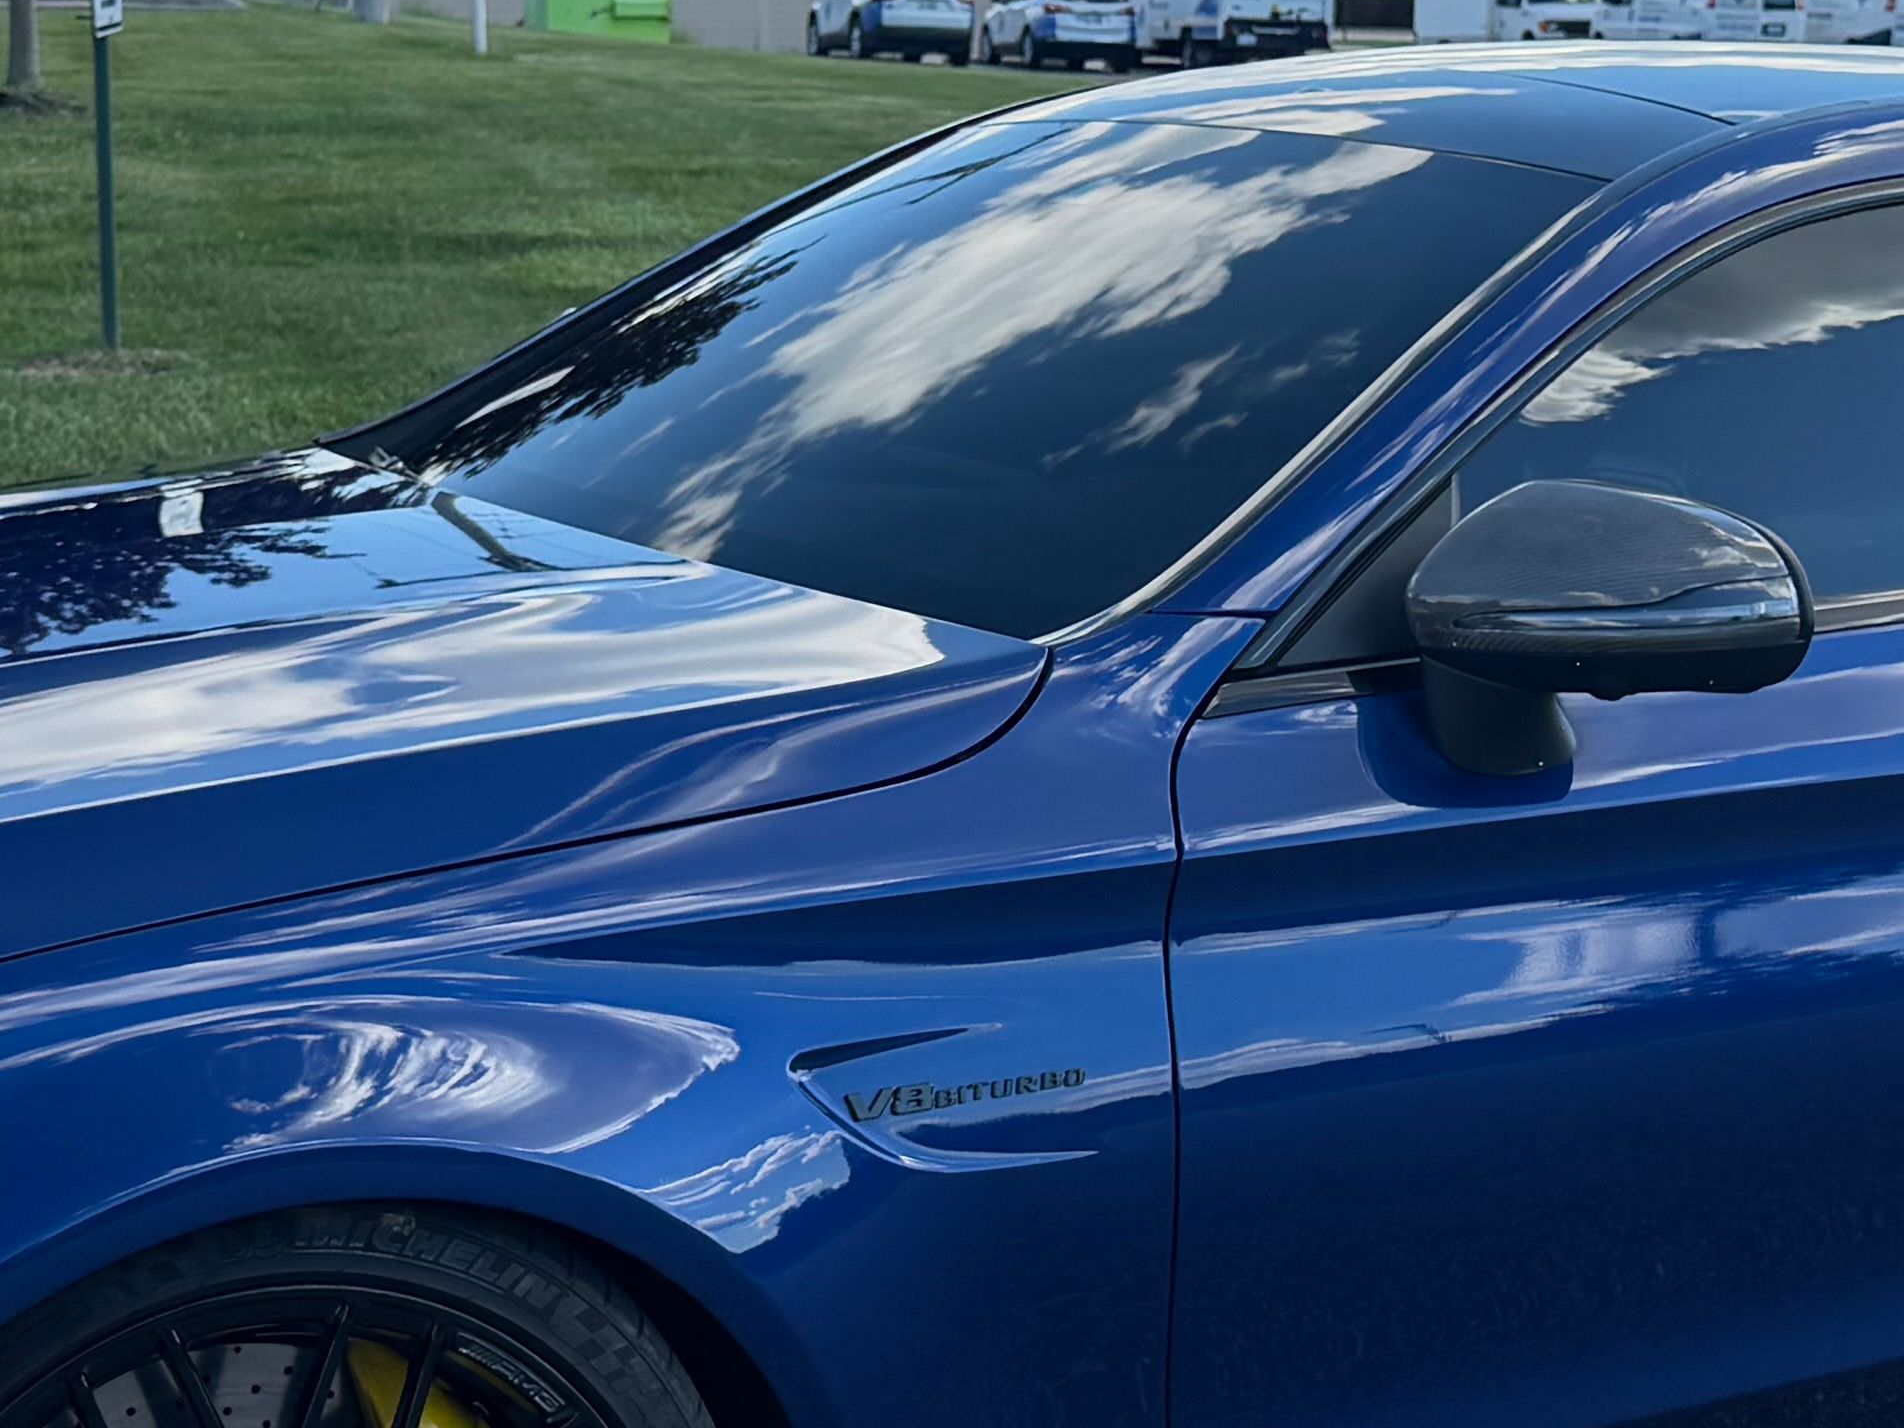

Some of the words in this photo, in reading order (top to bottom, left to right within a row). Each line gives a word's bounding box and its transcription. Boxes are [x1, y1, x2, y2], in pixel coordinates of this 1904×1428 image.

[843, 1081, 934, 1123] V8
[934, 1067, 1086, 1109] BITURBO
[293, 1212, 562, 1311] MICHELIN
